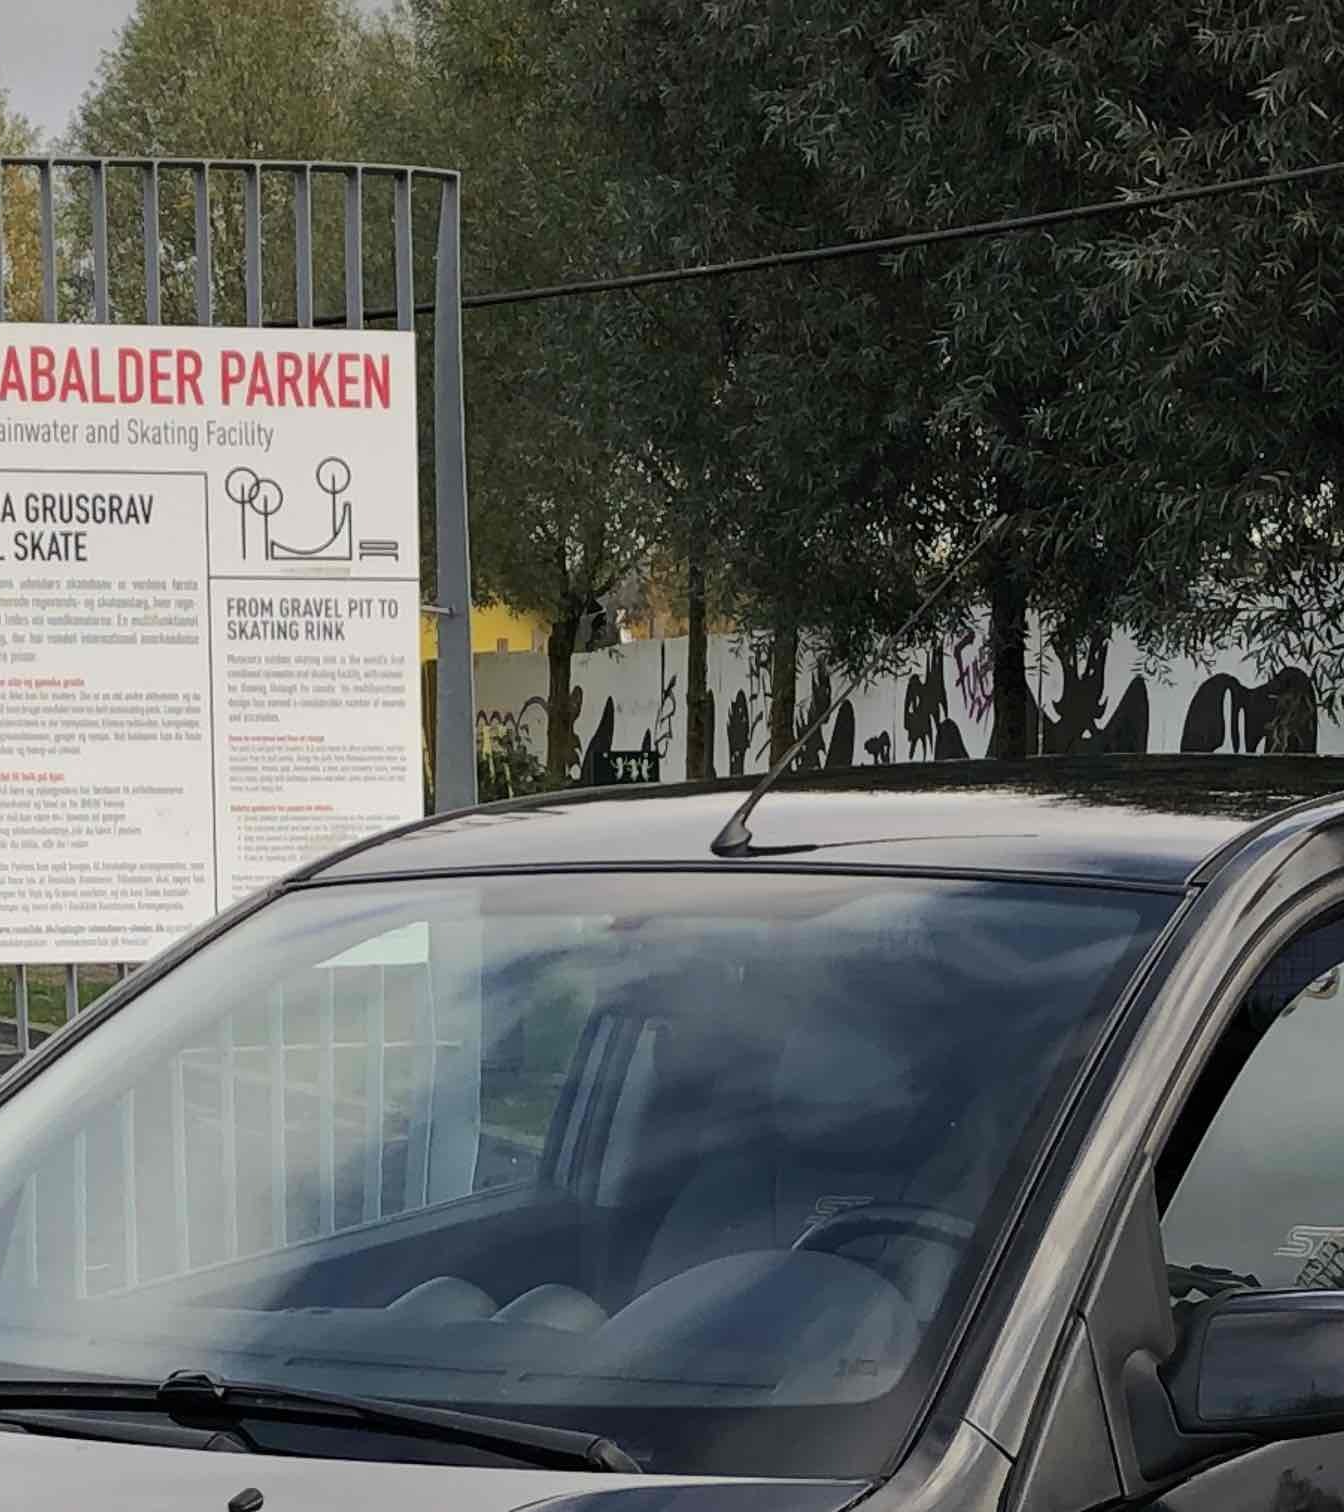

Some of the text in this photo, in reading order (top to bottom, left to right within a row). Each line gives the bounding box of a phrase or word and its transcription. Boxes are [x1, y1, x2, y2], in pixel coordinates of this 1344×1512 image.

[220, 350, 391, 409] PARKEN
[85, 418, 120, 445] and
[127, 417, 199, 453] Skating
[205, 419, 275, 453] Facility
[24, 492, 154, 525] GRUSGRAV
[13, 531, 88, 562] SKATE
[226, 597, 399, 620] FROM GRAVEL PIT TO
[227, 620, 345, 642] SKATING RINK
